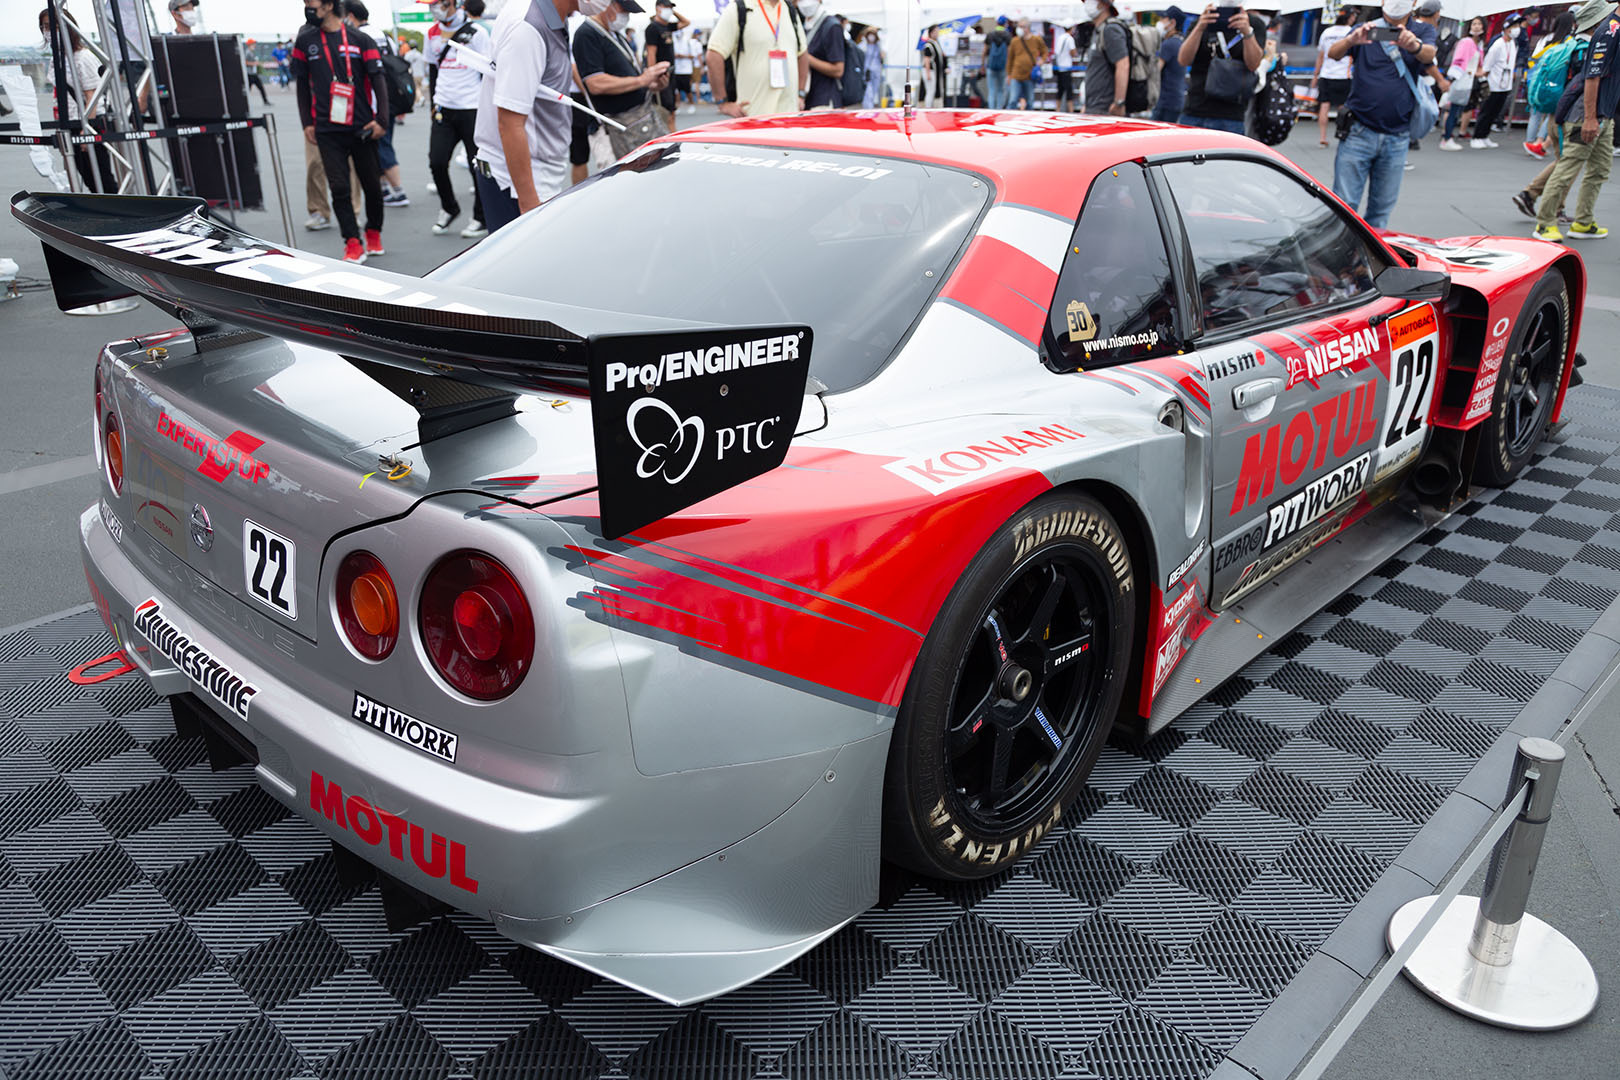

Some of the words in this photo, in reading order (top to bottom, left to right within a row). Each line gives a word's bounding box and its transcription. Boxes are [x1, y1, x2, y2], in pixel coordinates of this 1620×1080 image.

[10, 136, 41, 144] nismo
[125, 131, 157, 140] nismo
[177, 125, 207, 135] nismo
[226, 120, 253, 130] nismo
[779, 159, 893, 181] RE-01
[1068, 311, 1088, 332] 30
[1083, 329, 1158, 352] www.nismo.co.jp
[1399, 313, 1435, 336] AUTOBACS
[1304, 328, 1380, 379] NISSAN
[1385, 339, 1433, 448] 22
[905, 423, 1087, 484] KONAMI
[1229, 379, 1379, 516] MOTUL
[1263, 453, 1371, 549] PITWORK
[250, 529, 290, 612] 22
[1012, 509, 1135, 595] BRIDGESTONE
[135, 599, 258, 718] BRIDGESTONE
[1054, 643, 1089, 667] nismo
[354, 694, 455, 761] PITWORK
[309, 770, 479, 894] MOTUL
